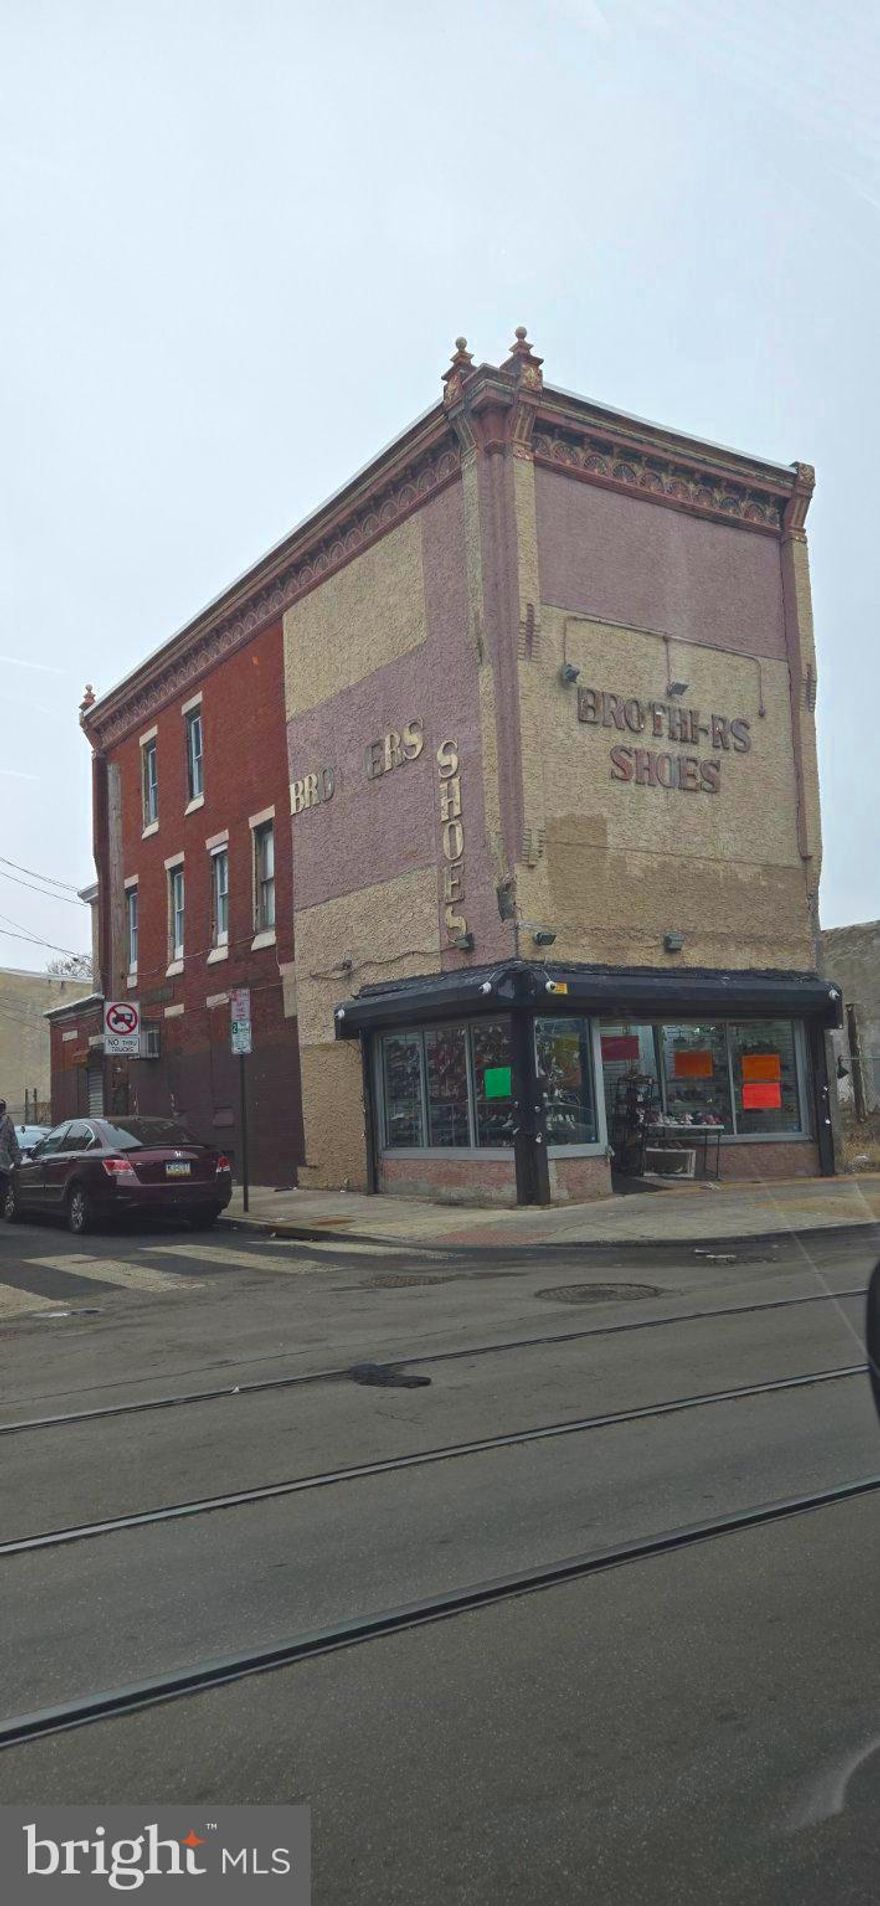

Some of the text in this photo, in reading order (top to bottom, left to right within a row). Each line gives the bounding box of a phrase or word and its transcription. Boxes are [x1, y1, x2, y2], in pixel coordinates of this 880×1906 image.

[609, 744, 721, 794] SHOES
[436, 740, 468, 944] SHOES
[107, 1038, 137, 1047] NO THRU
